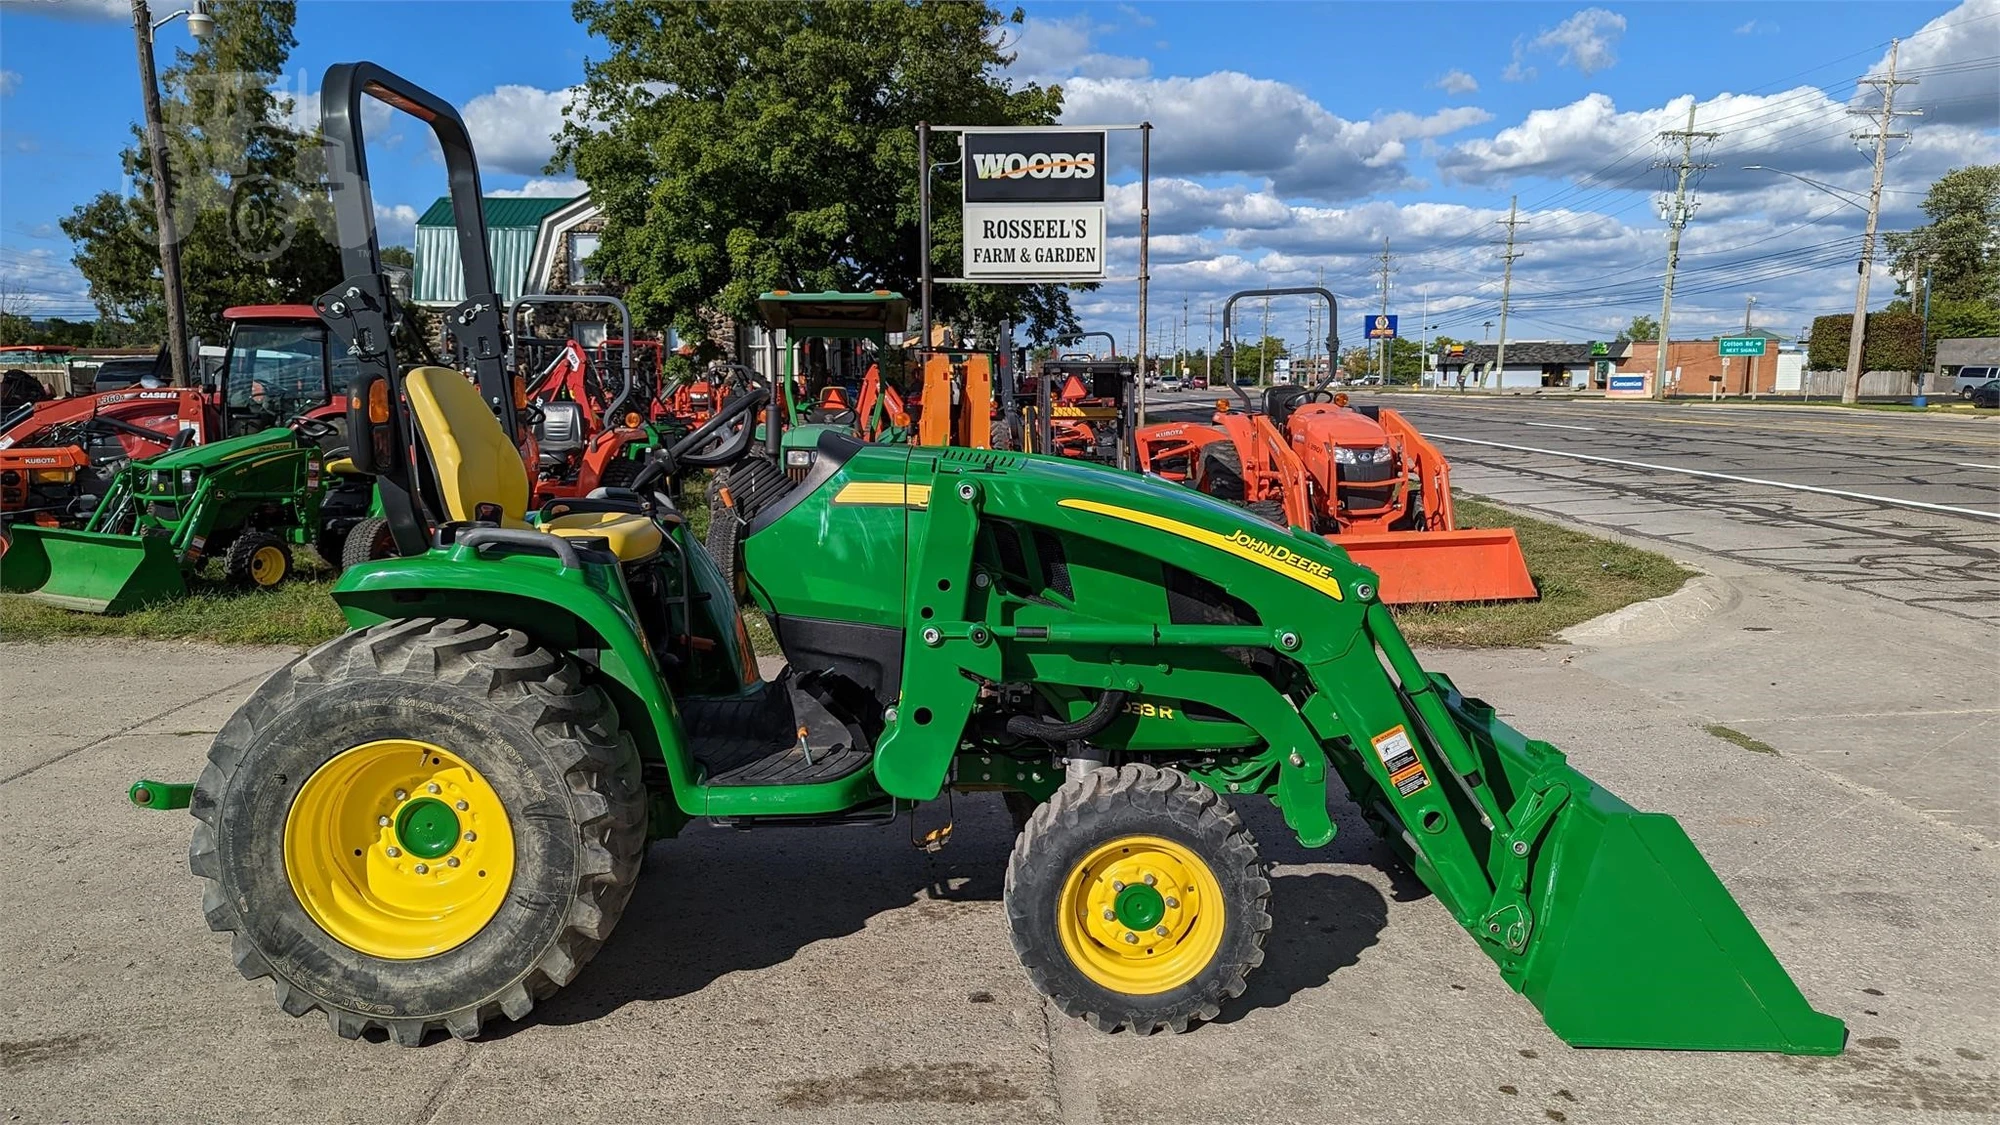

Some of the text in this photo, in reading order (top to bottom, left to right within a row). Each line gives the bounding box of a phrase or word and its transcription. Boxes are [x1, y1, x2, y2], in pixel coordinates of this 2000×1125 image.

[972, 152, 1096, 179] WOODS
[982, 218, 1088, 239] ROSSEEL'S
[973, 247, 1097, 263] FARM & GARDEN
[25, 456, 57, 465] KUBOTA
[1224, 529, 1334, 580] JOHN DEERE
